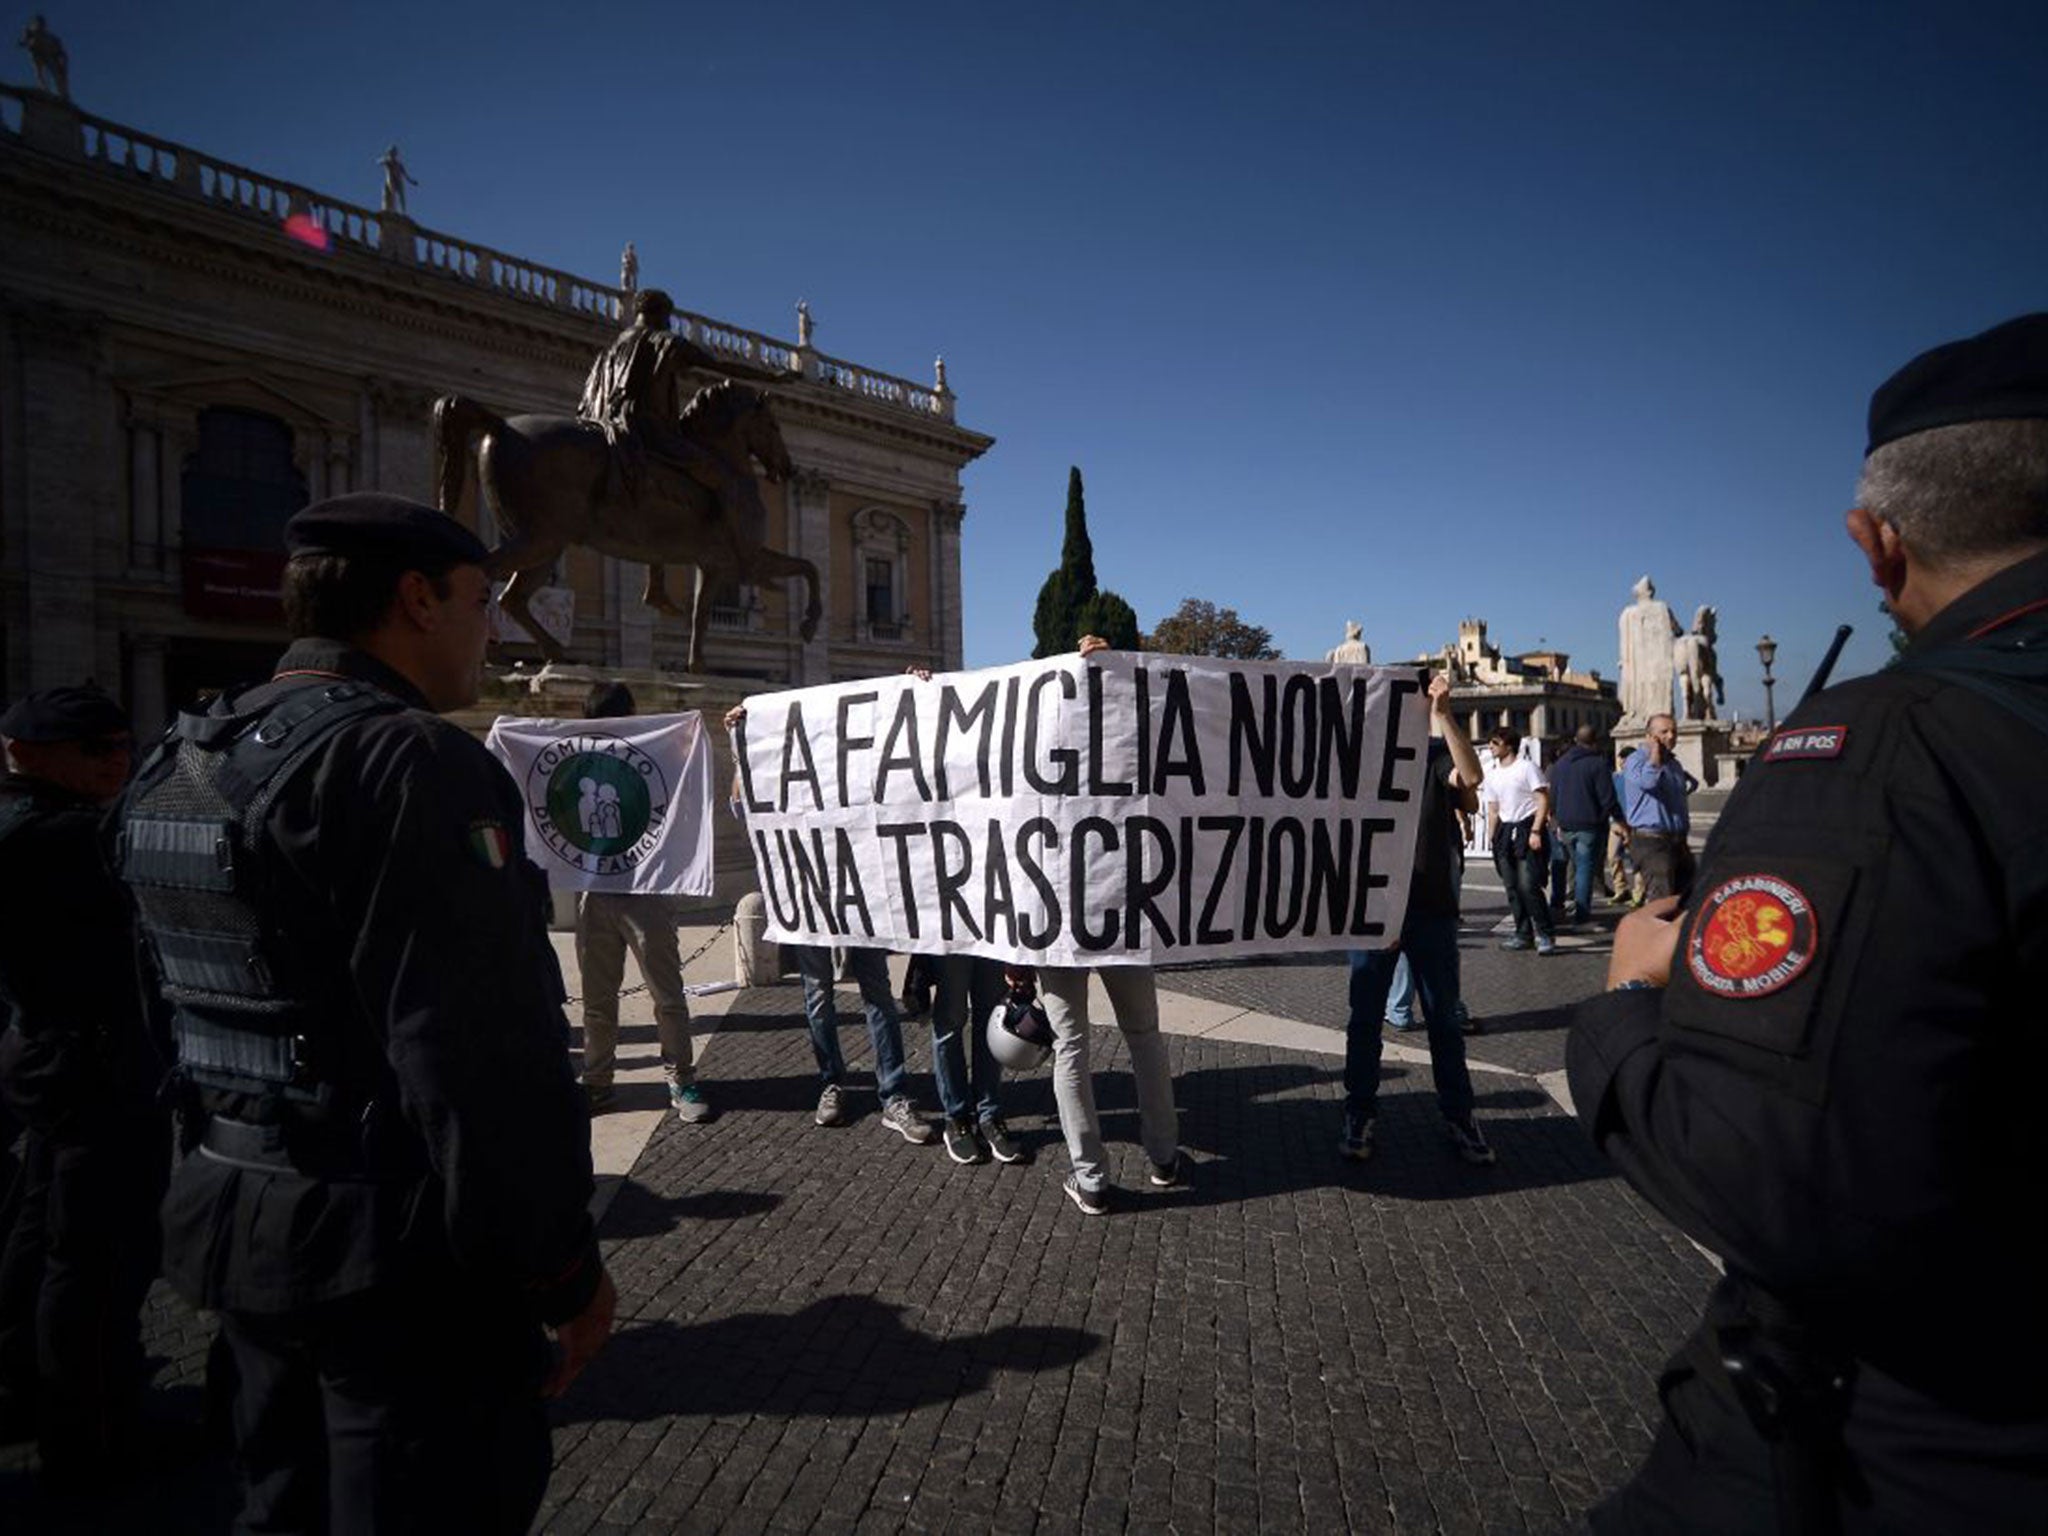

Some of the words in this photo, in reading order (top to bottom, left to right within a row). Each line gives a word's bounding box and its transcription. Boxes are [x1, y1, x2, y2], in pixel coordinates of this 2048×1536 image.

[537, 736, 654, 776] COMITATO
[735, 700, 824, 813] LA
[836, 666, 1205, 807] FAMIGLIA
[1228, 672, 1366, 799] NON
[1805, 734, 1837, 750] POS
[534, 806, 584, 869] DELLA
[597, 803, 667, 873] FAMIGLIA
[756, 827, 875, 938] UNA
[876, 816, 1395, 950] TRASCRIZIONE
[1714, 878, 1807, 915] CARABINIERI
[1742, 950, 1805, 992] MOBILE
